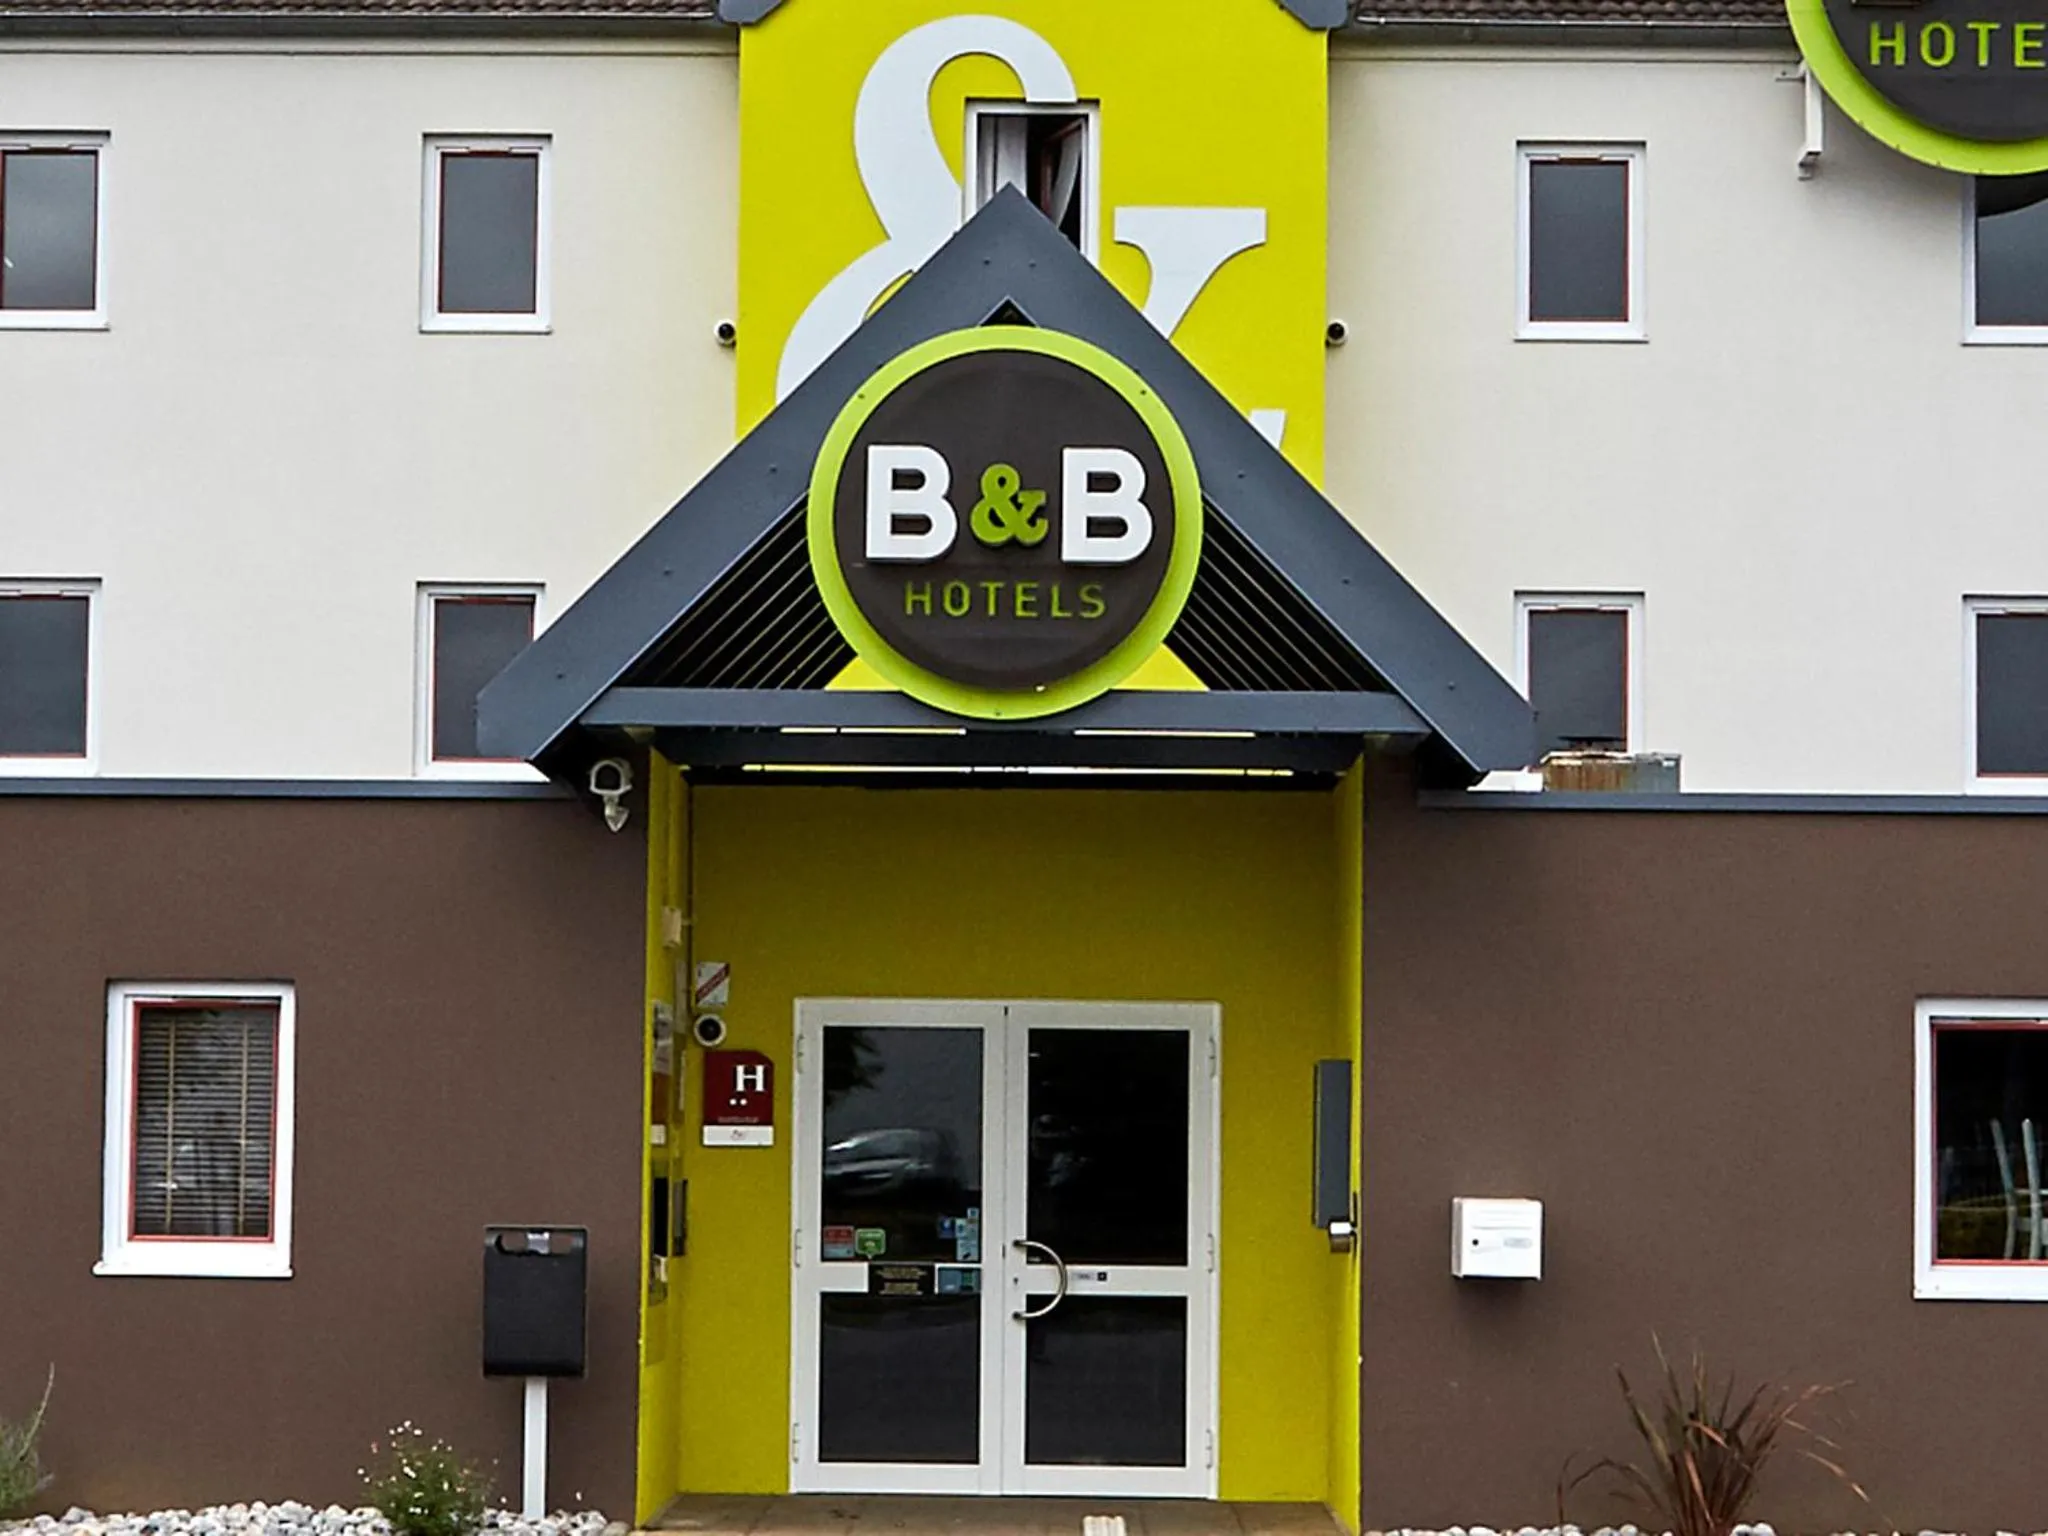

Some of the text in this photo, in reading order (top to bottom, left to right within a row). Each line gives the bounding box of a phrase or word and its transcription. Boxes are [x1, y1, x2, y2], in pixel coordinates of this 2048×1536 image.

[1870, 22, 2046, 67] HOTE
[905, 580, 1106, 618] HOTELS
[735, 1064, 765, 1092] H
